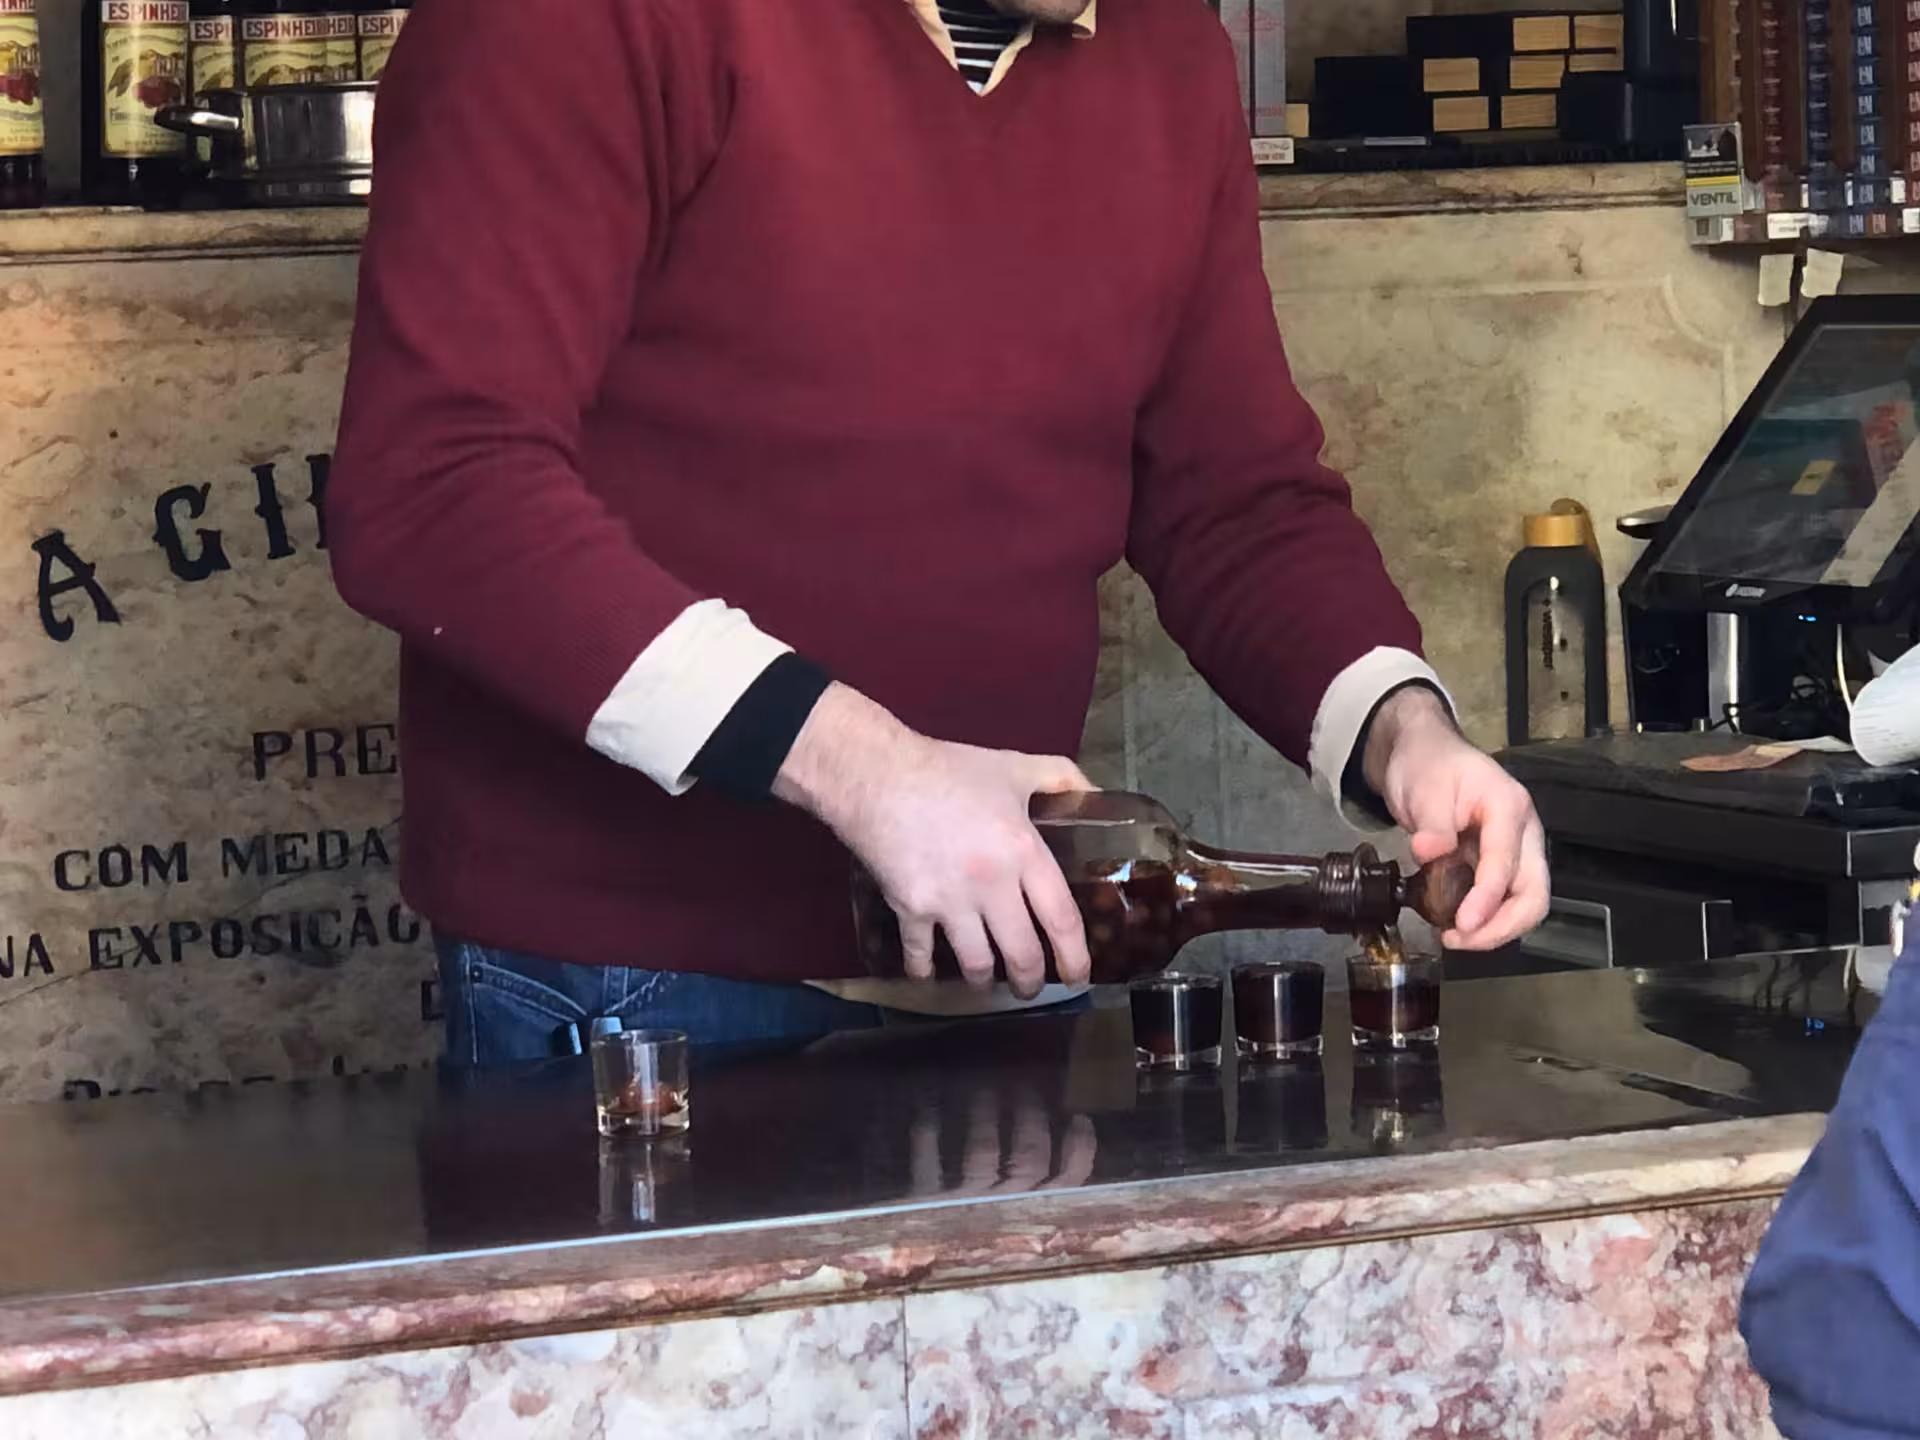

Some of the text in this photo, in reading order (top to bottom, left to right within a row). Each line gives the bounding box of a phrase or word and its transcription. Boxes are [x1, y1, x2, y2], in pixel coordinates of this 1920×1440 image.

[1690, 191, 1738, 206] VENTIL
[32, 529, 121, 642] A
[252, 723, 398, 781] PRE
[54, 827, 392, 891] COM MEDA
